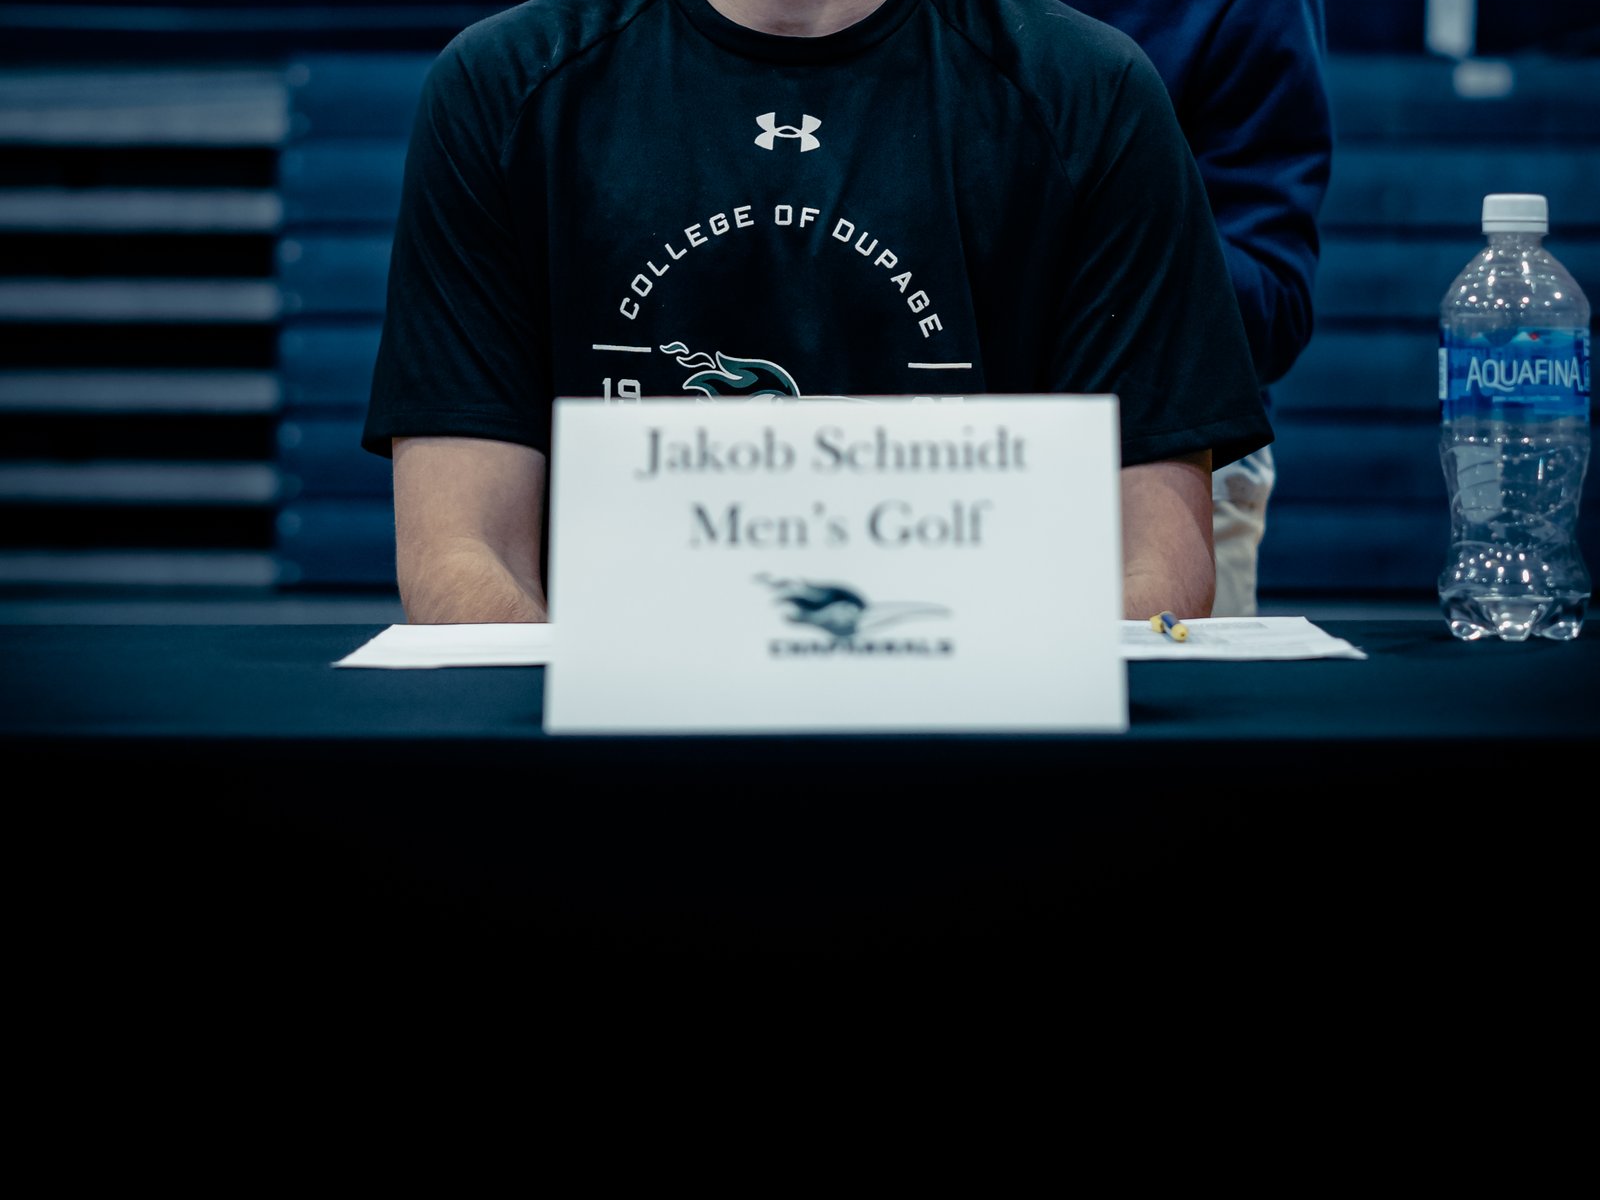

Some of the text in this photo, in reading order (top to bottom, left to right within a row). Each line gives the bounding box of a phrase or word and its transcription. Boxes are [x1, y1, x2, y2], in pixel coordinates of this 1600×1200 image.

[619, 204, 943, 338] COLLEGE OF DUPAGE
[1466, 356, 1584, 392] AQUAFINA
[635, 425, 1028, 480] Jakob Schmidt
[689, 501, 992, 549] Men's Golf
